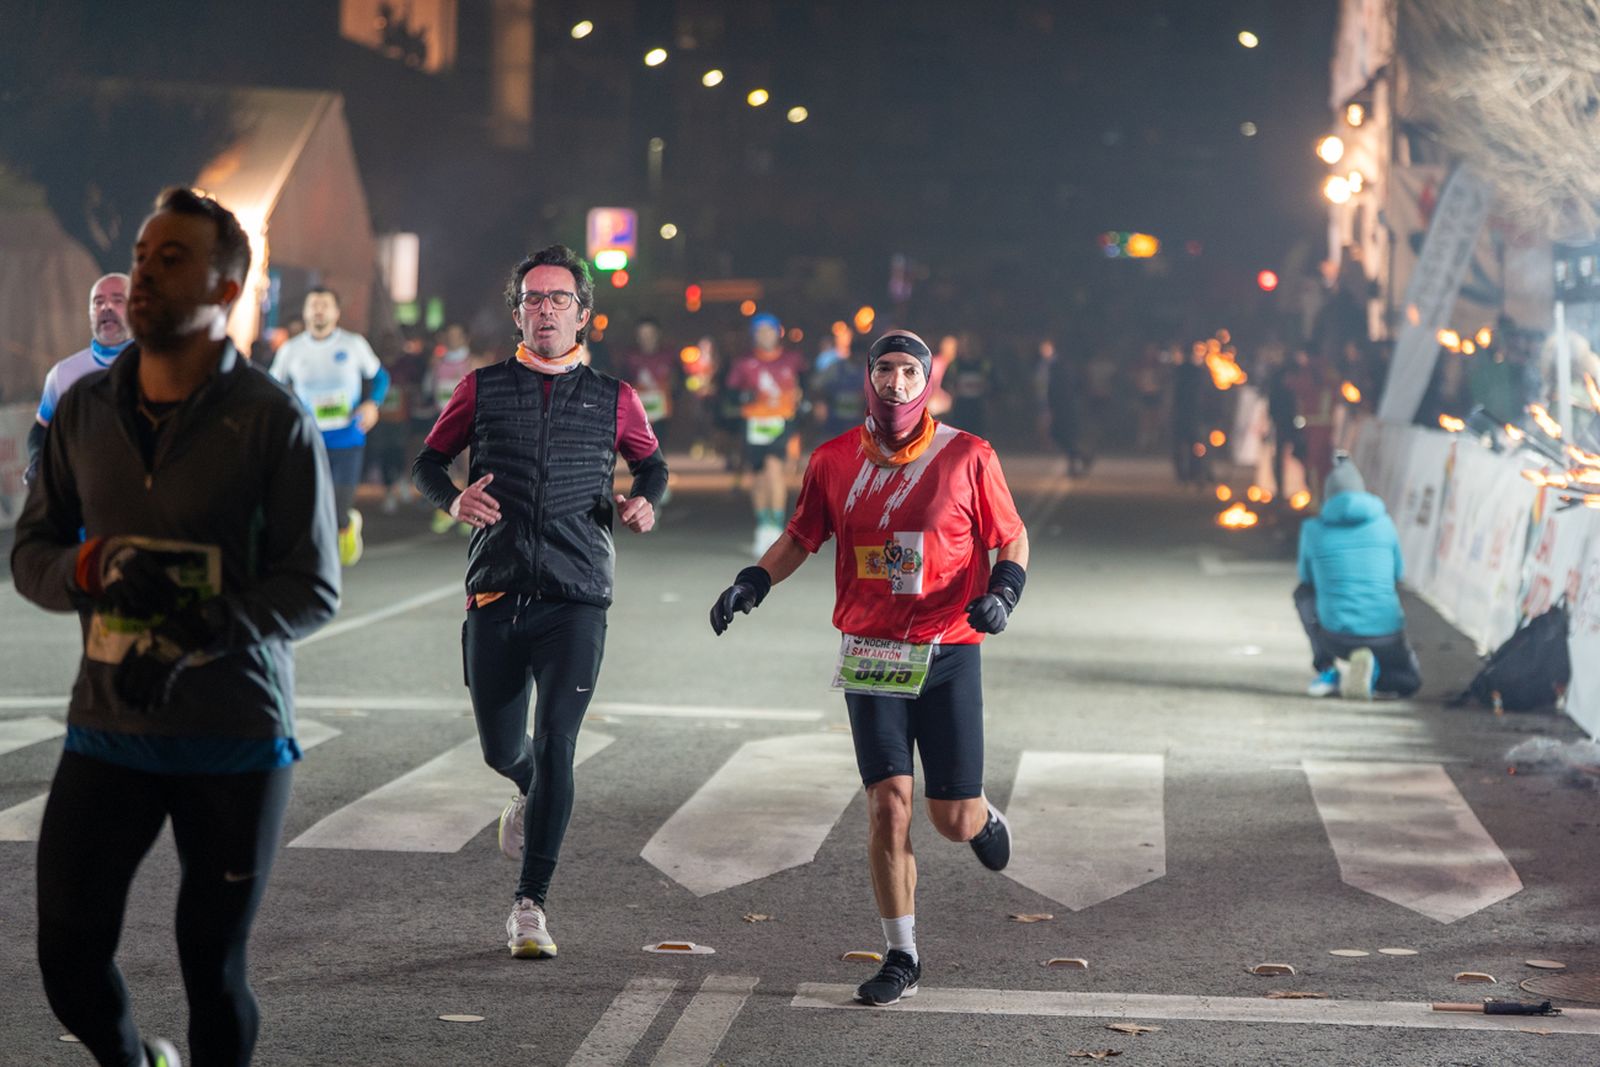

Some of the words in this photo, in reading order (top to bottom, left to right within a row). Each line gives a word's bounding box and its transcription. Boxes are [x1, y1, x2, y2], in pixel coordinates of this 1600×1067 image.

[864, 638, 891, 648] NOCHE
[852, 647, 871, 658] SAN
[871, 648, 902, 661] ANTÓN
[855, 659, 913, 683] 8475
